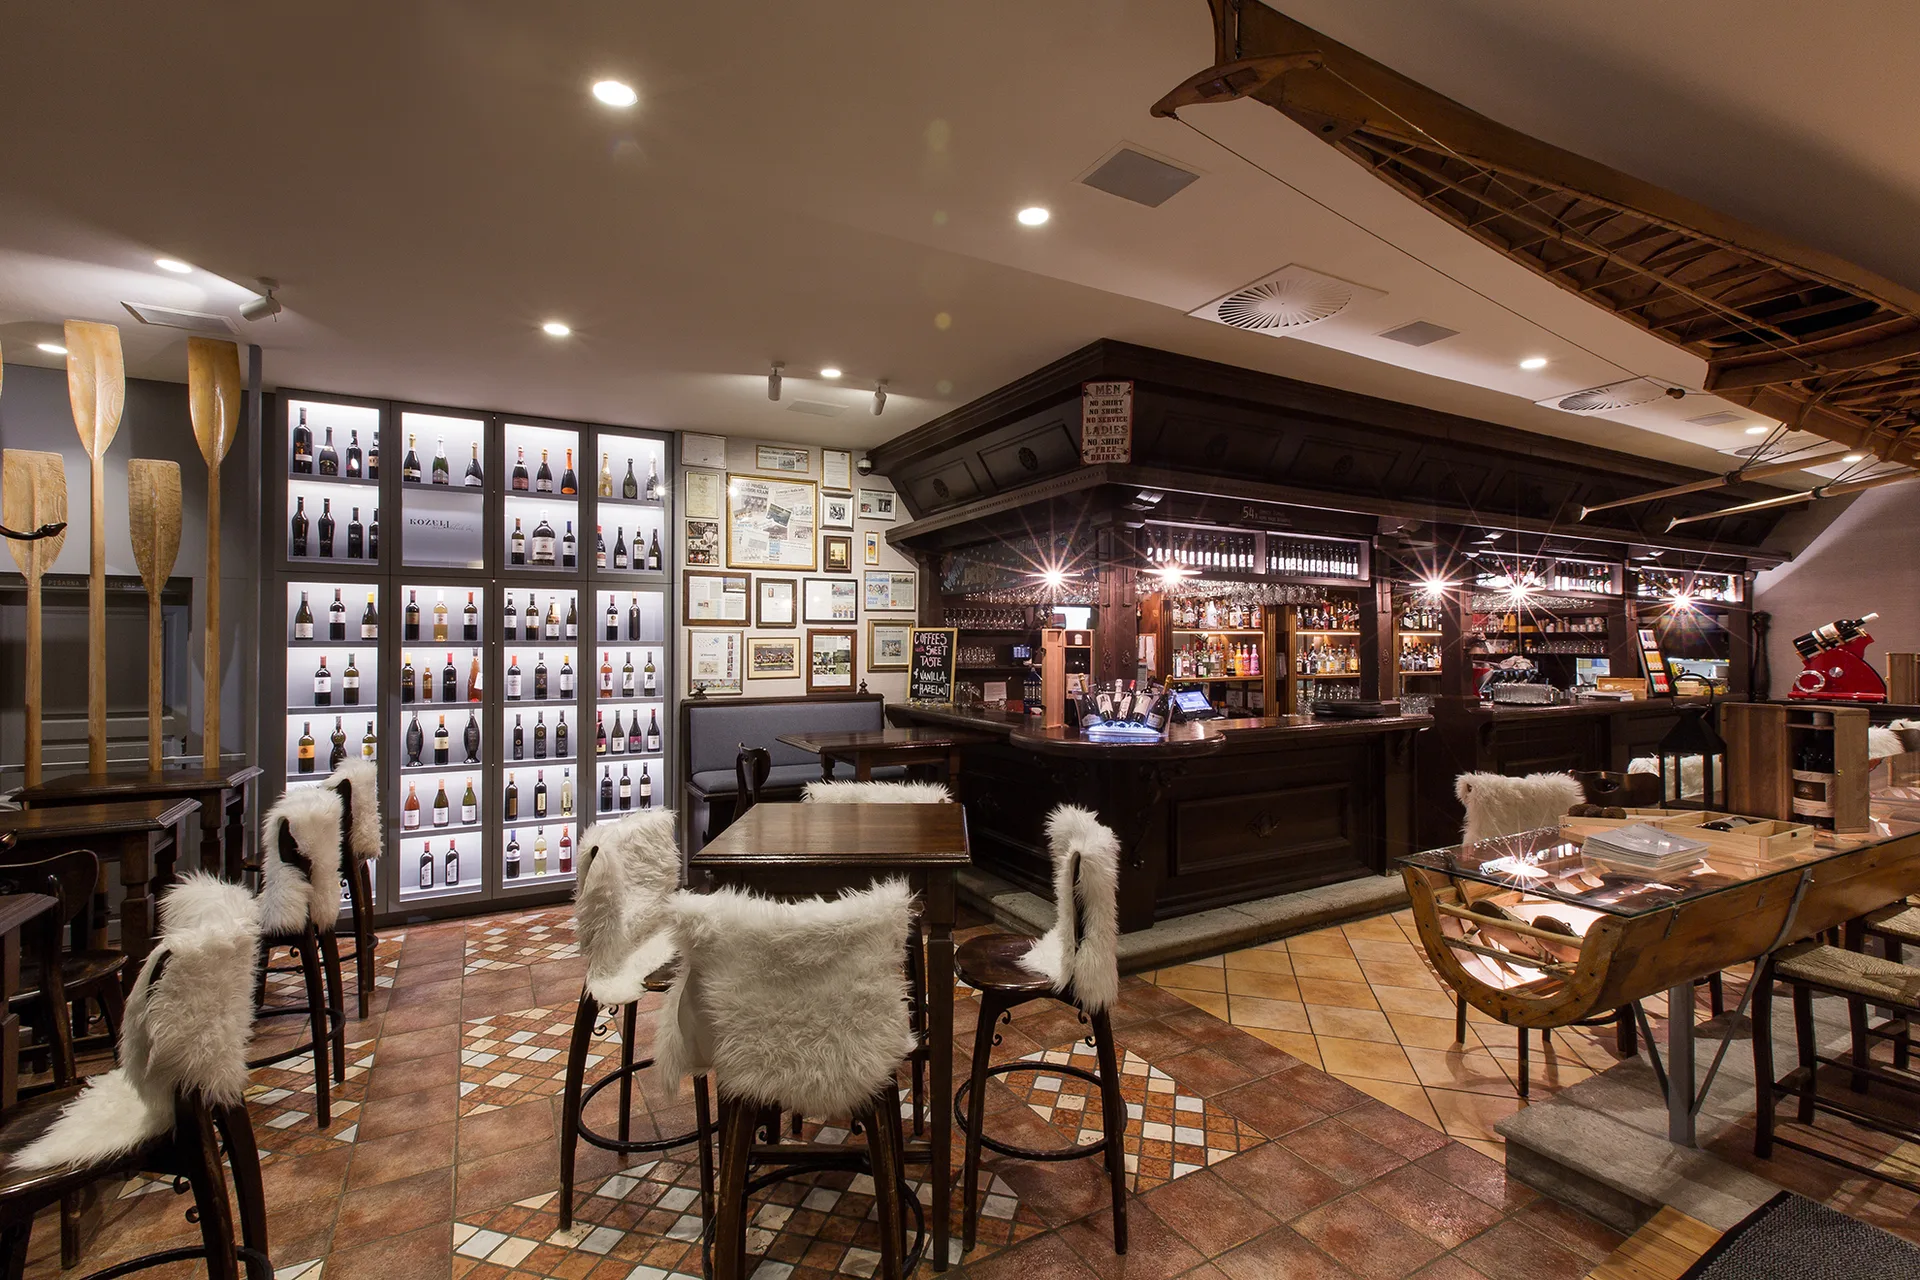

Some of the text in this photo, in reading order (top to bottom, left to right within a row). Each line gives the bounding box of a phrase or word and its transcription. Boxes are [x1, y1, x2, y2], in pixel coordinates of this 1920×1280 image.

[1095, 385, 1121, 395] MEN
[1101, 399, 1124, 407] SHIRT
[1085, 425, 1128, 435] LADIES
[914, 632, 948, 645] COFFEES
[920, 656, 942, 667] TASTE
[920, 671, 947, 682] VANILLA
[919, 684, 950, 697] HAZELNUT
